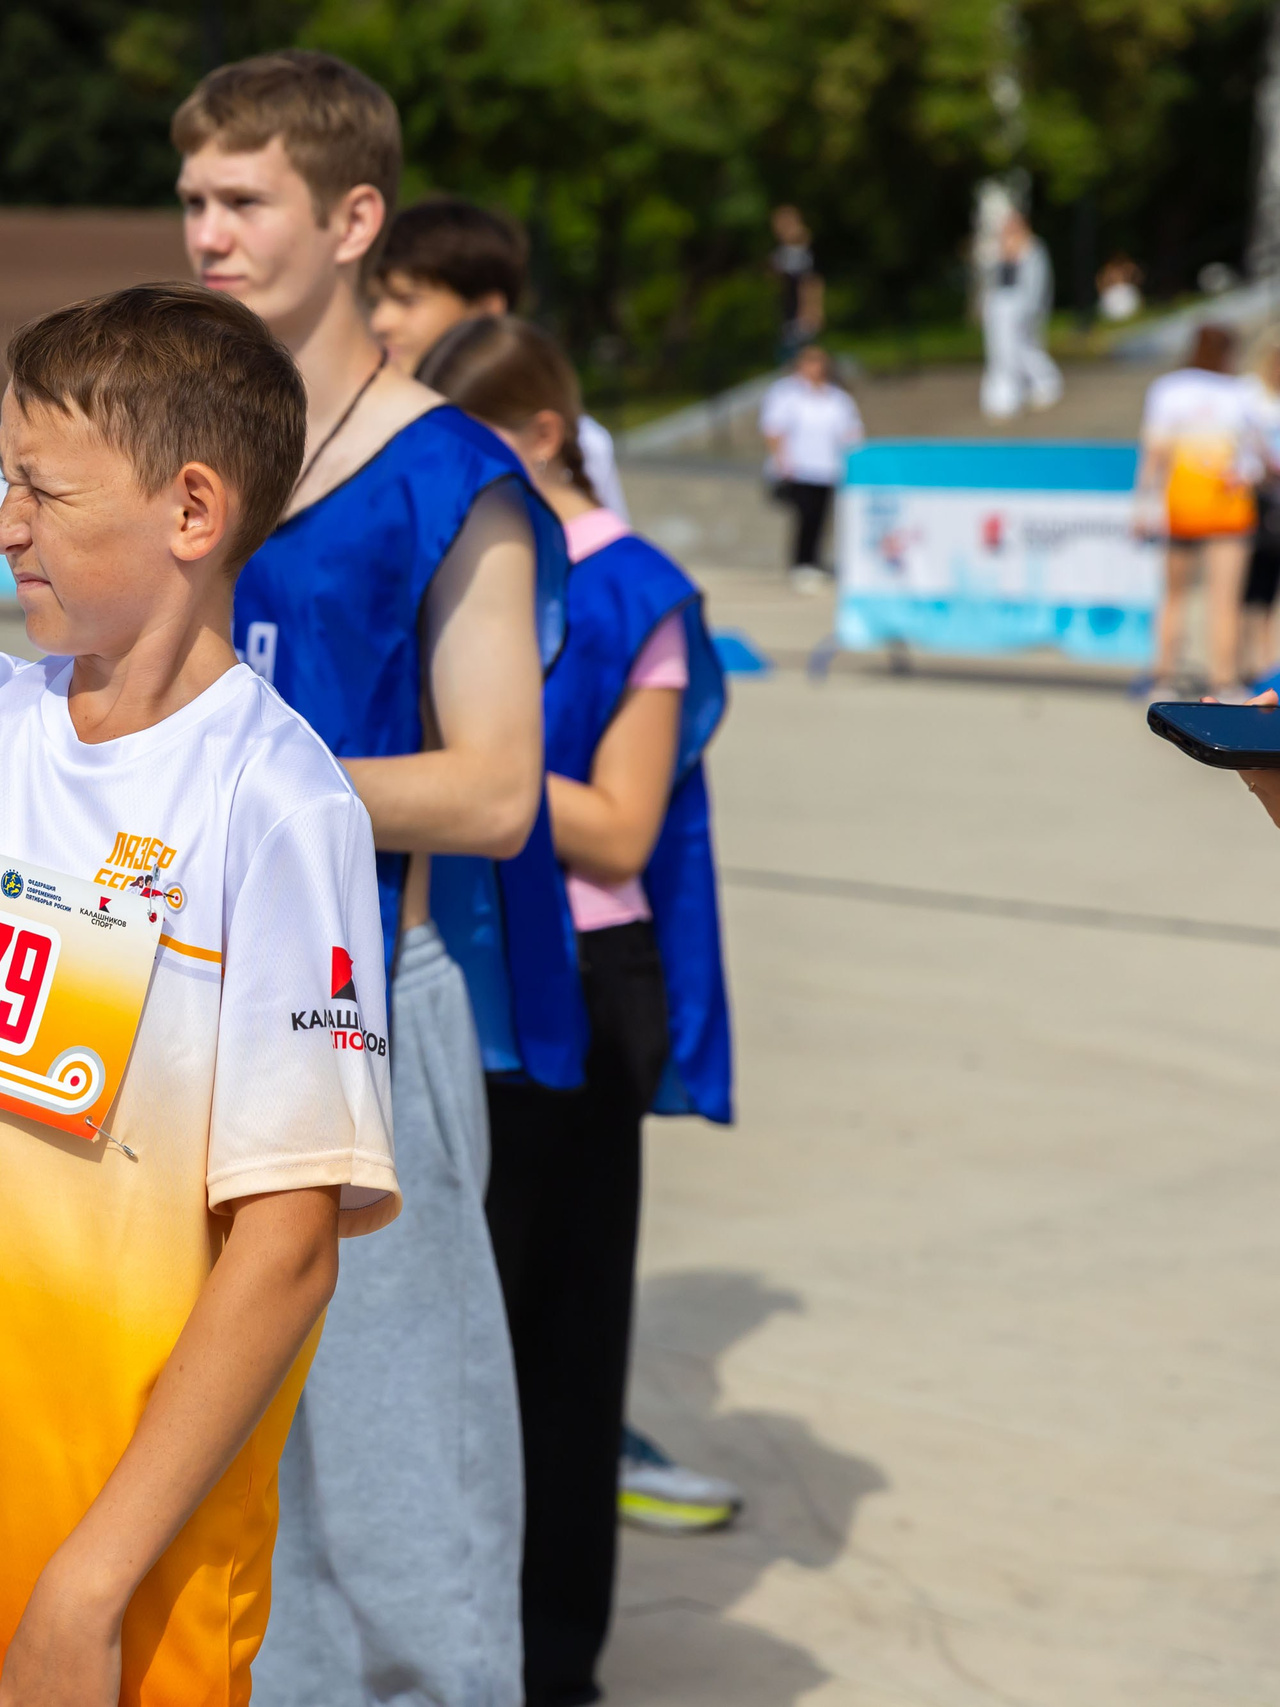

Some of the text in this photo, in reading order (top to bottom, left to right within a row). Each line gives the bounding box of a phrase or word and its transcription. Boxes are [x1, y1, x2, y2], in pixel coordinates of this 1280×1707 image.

[105, 831, 177, 871] ЛАЗЕР
[26, 886, 62, 902] СОВРЕМЕННОГО
[27, 879, 56, 892] ФЕДЕРАЦИЯ
[25, 893, 72, 912] ПЯТИБОРЬЯ РОССИИ
[79, 907, 127, 928] КАЛАШНИКОВ
[91, 918, 113, 930] СПОРТ
